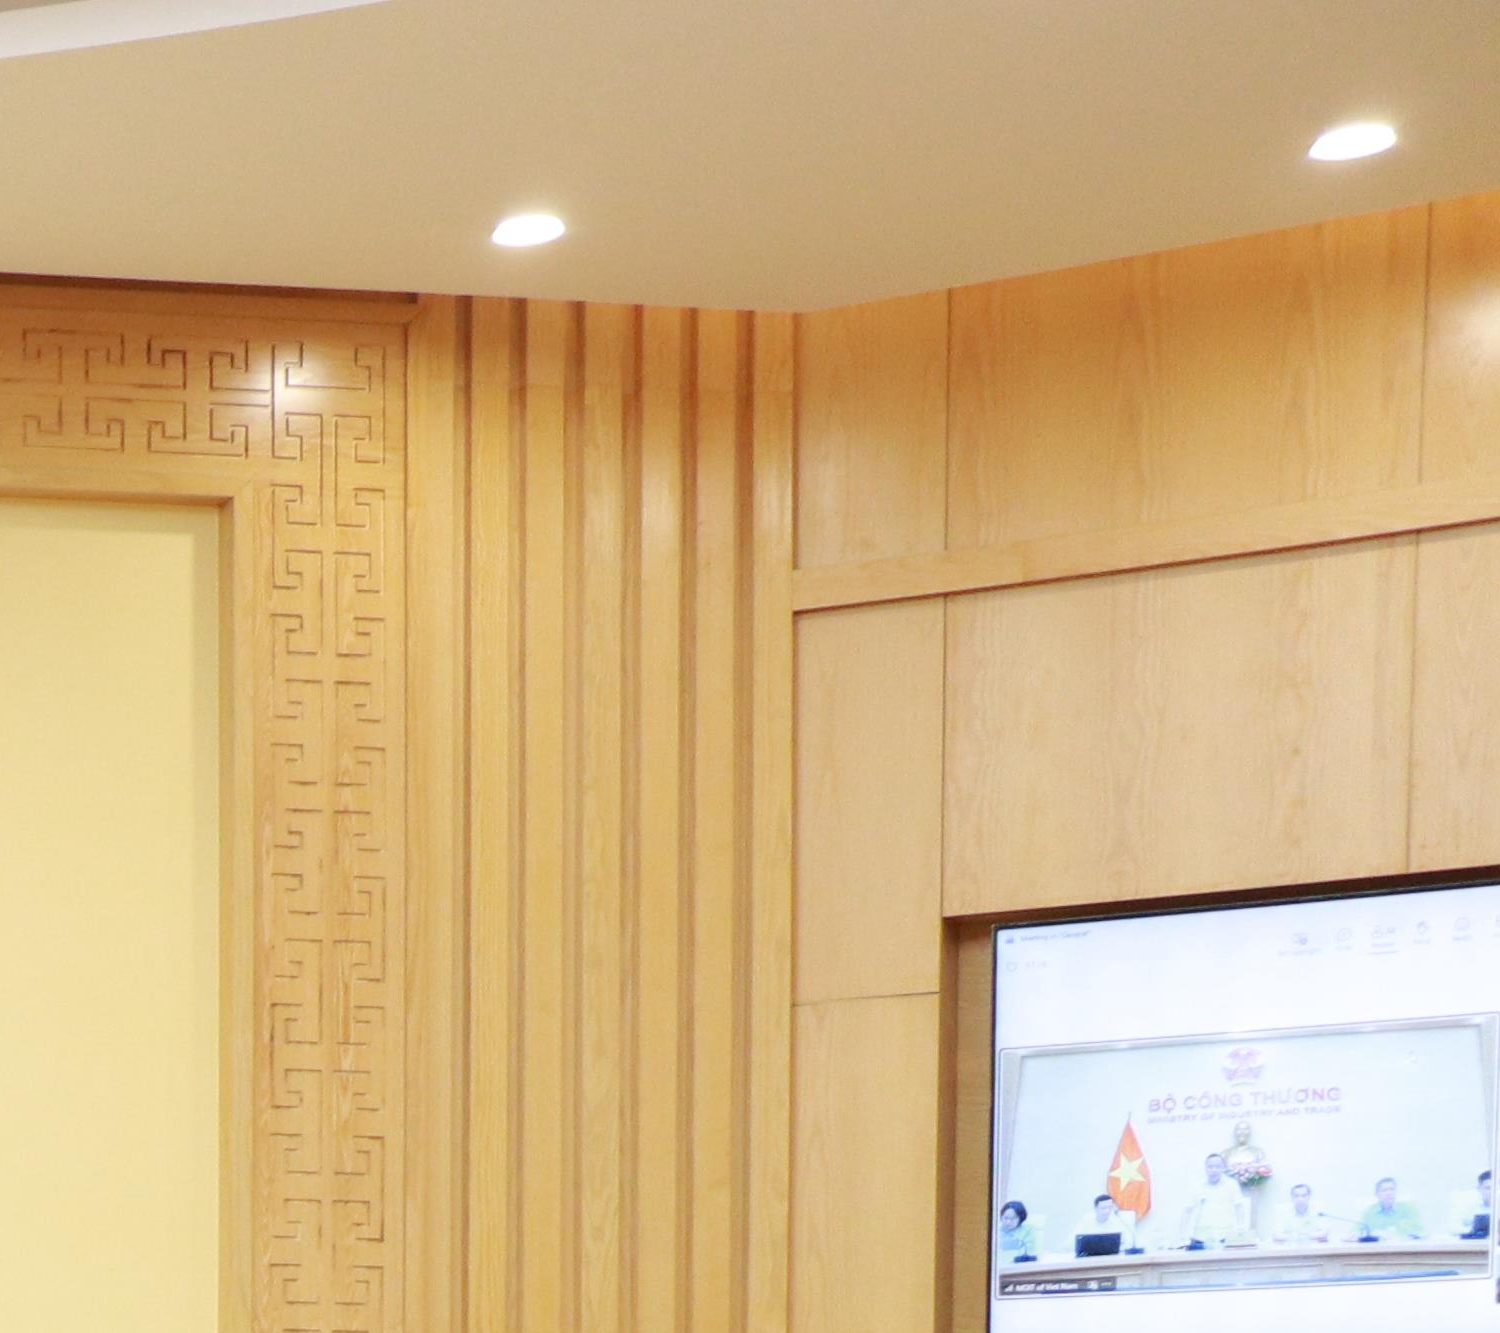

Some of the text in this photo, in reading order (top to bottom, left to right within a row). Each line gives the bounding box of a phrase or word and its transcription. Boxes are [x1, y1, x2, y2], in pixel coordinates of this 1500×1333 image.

[1148, 1085, 1341, 1114] BỘ CÔNG THƯƠNG
